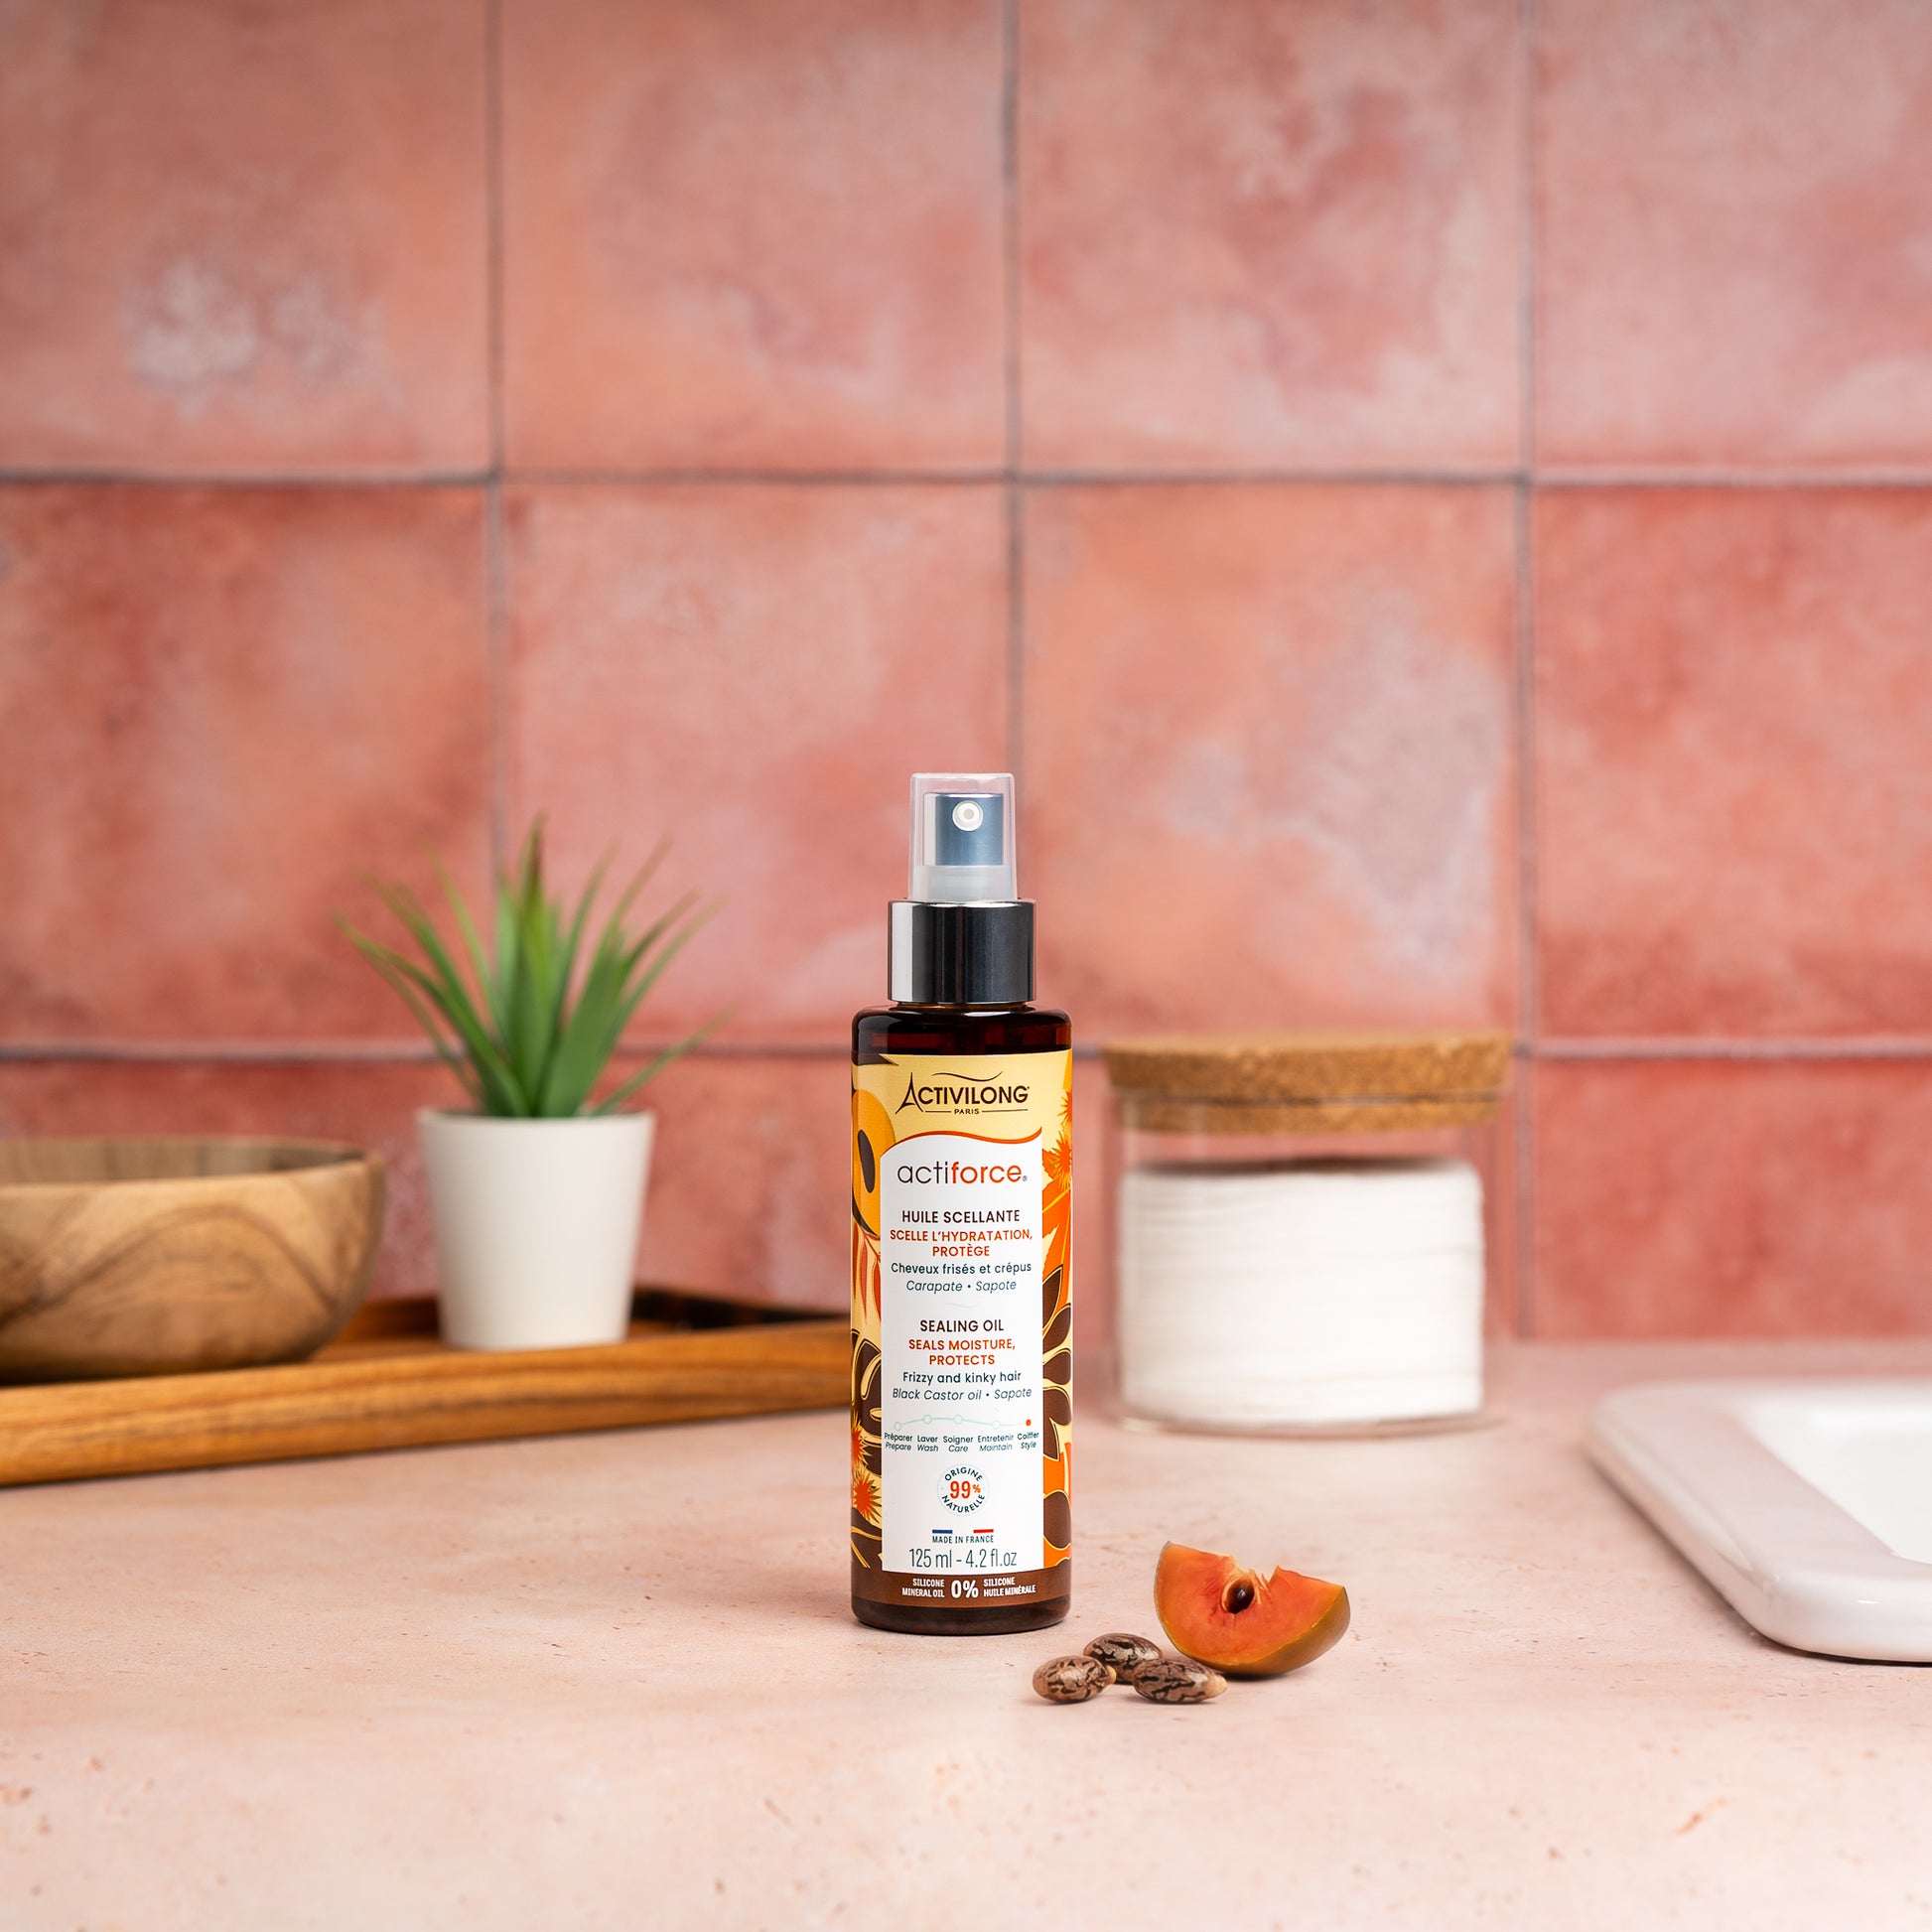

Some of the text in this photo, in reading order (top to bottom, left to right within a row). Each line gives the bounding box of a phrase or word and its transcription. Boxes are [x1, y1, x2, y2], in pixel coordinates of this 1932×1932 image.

[895, 1072, 1030, 1114] ACTIVILONG
[902, 1209, 1020, 1223] HUILE SCELLANTE
[891, 1229, 928, 1241] SCELLE
[932, 1244, 990, 1257] PROTÈGE
[892, 1263, 1032, 1275] Cheveux frisés et crépus
[906, 1280, 962, 1294] Carapate
[976, 1280, 1017, 1294] Sapote
[920, 1319, 1004, 1332] SEALING OIL
[908, 1338, 1016, 1350] SEALS MOISTURE,
[929, 1354, 995, 1366] PROTECTS
[902, 1371, 1021, 1386] Frizzy and kinky hair
[893, 1388, 920, 1400] Black
[923, 1389, 963, 1401] Castor
[968, 1389, 981, 1400] oil
[994, 1387, 1033, 1401] Sapote
[884, 1431, 1039, 1445] Préparer Laver Soigner Entretenir Coiffer
[1021, 1441, 1036, 1450] Style
[944, 1466, 983, 1481] ORIGINE
[950, 1480, 981, 1499] 99%
[942, 1494, 985, 1513] NATURELLE
[966, 1535, 994, 1544] FRANCE
[909, 1548, 931, 1568] 125
[936, 1549, 952, 1568] ml
[965, 1549, 987, 1568] 4.2
[990, 1548, 1017, 1567] fl.oz
[912, 1578, 944, 1587] SILICONE
[983, 1577, 1016, 1587] SILICONE
[902, 1587, 932, 1597] MINERAL
[950, 1580, 979, 1598] 0%
[983, 1585, 1035, 1597] HUILE MINÉRALE
